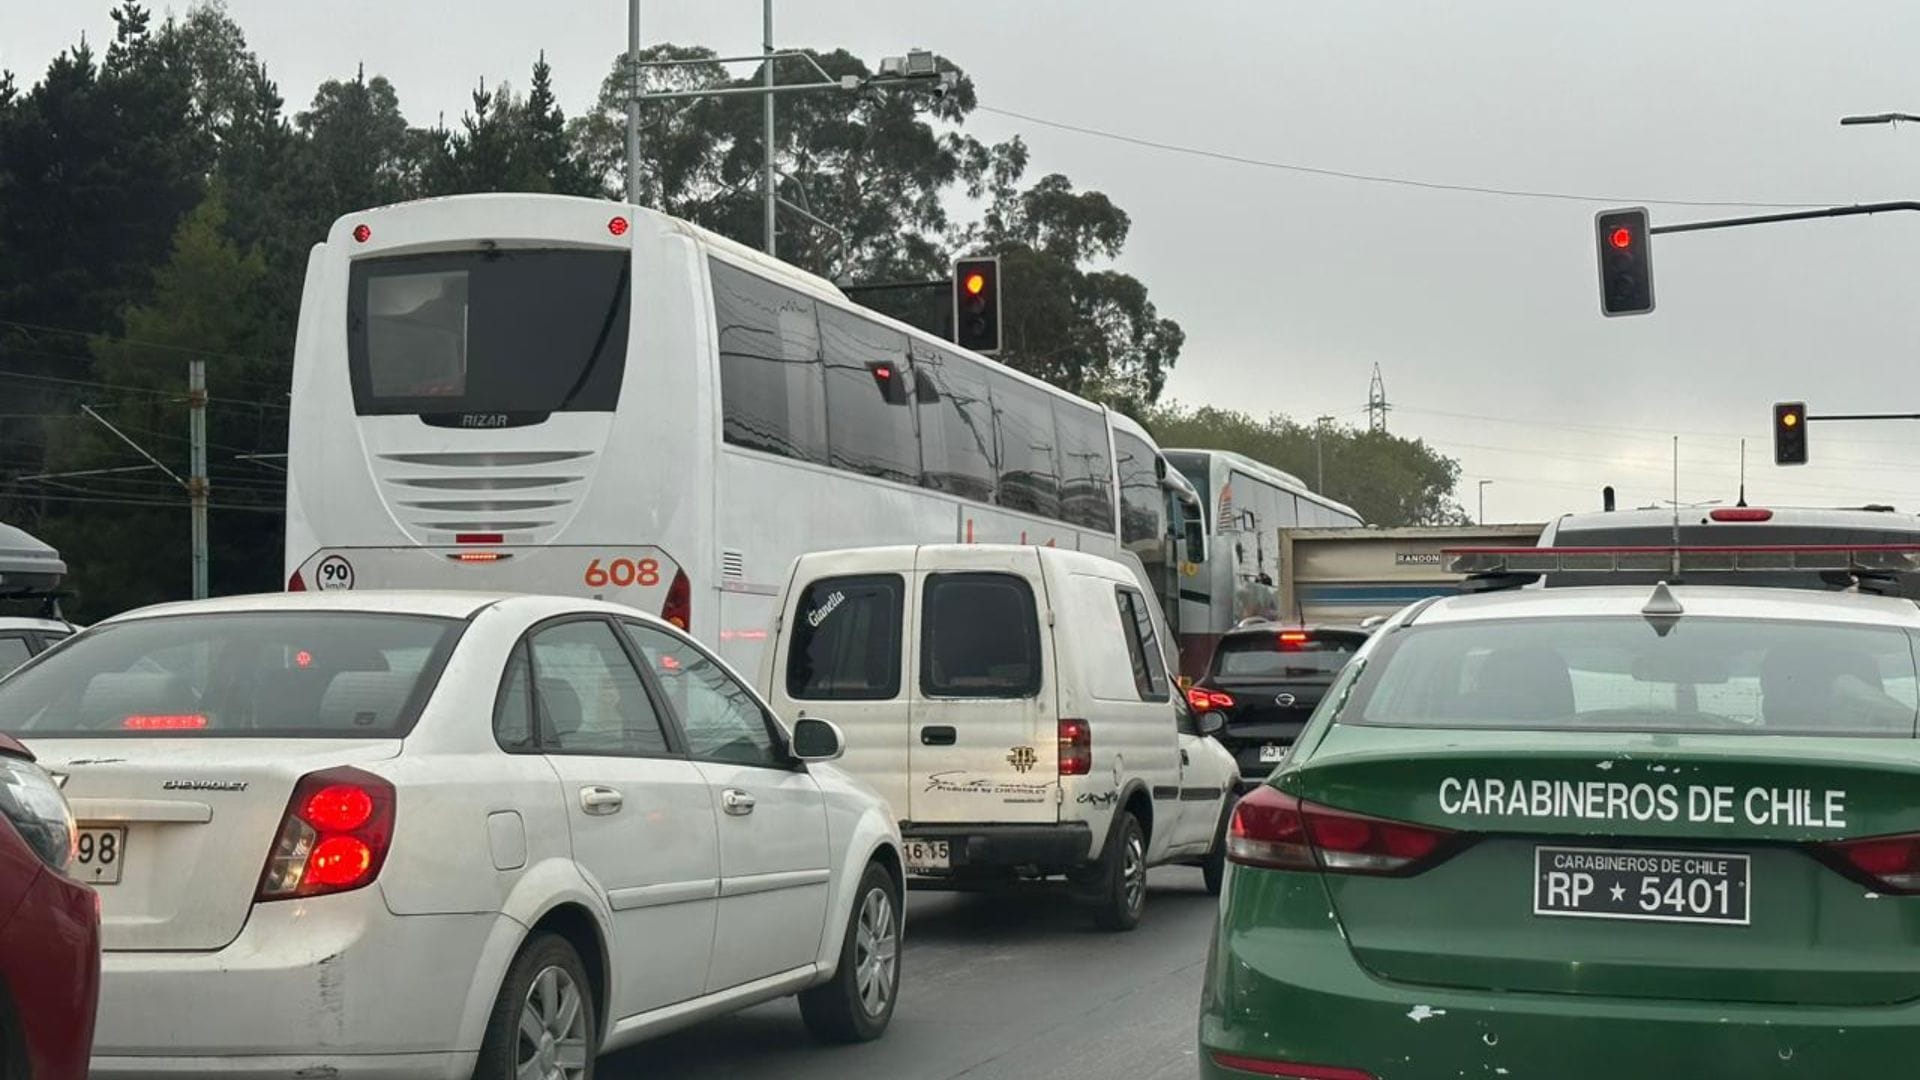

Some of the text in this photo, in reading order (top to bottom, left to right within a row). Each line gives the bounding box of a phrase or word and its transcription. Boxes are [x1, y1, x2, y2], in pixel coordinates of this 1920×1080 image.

[323, 564, 348, 580] 90
[584, 558, 660, 587] 608
[163, 779, 248, 792] CHEVROLET
[1439, 777, 1847, 828] CARABINEROS DE CHILE
[78, 832, 116, 864] 98
[1554, 854, 1728, 876] CARABINEROS DE CHILE
[1547, 872, 1729, 914] RP 5401
